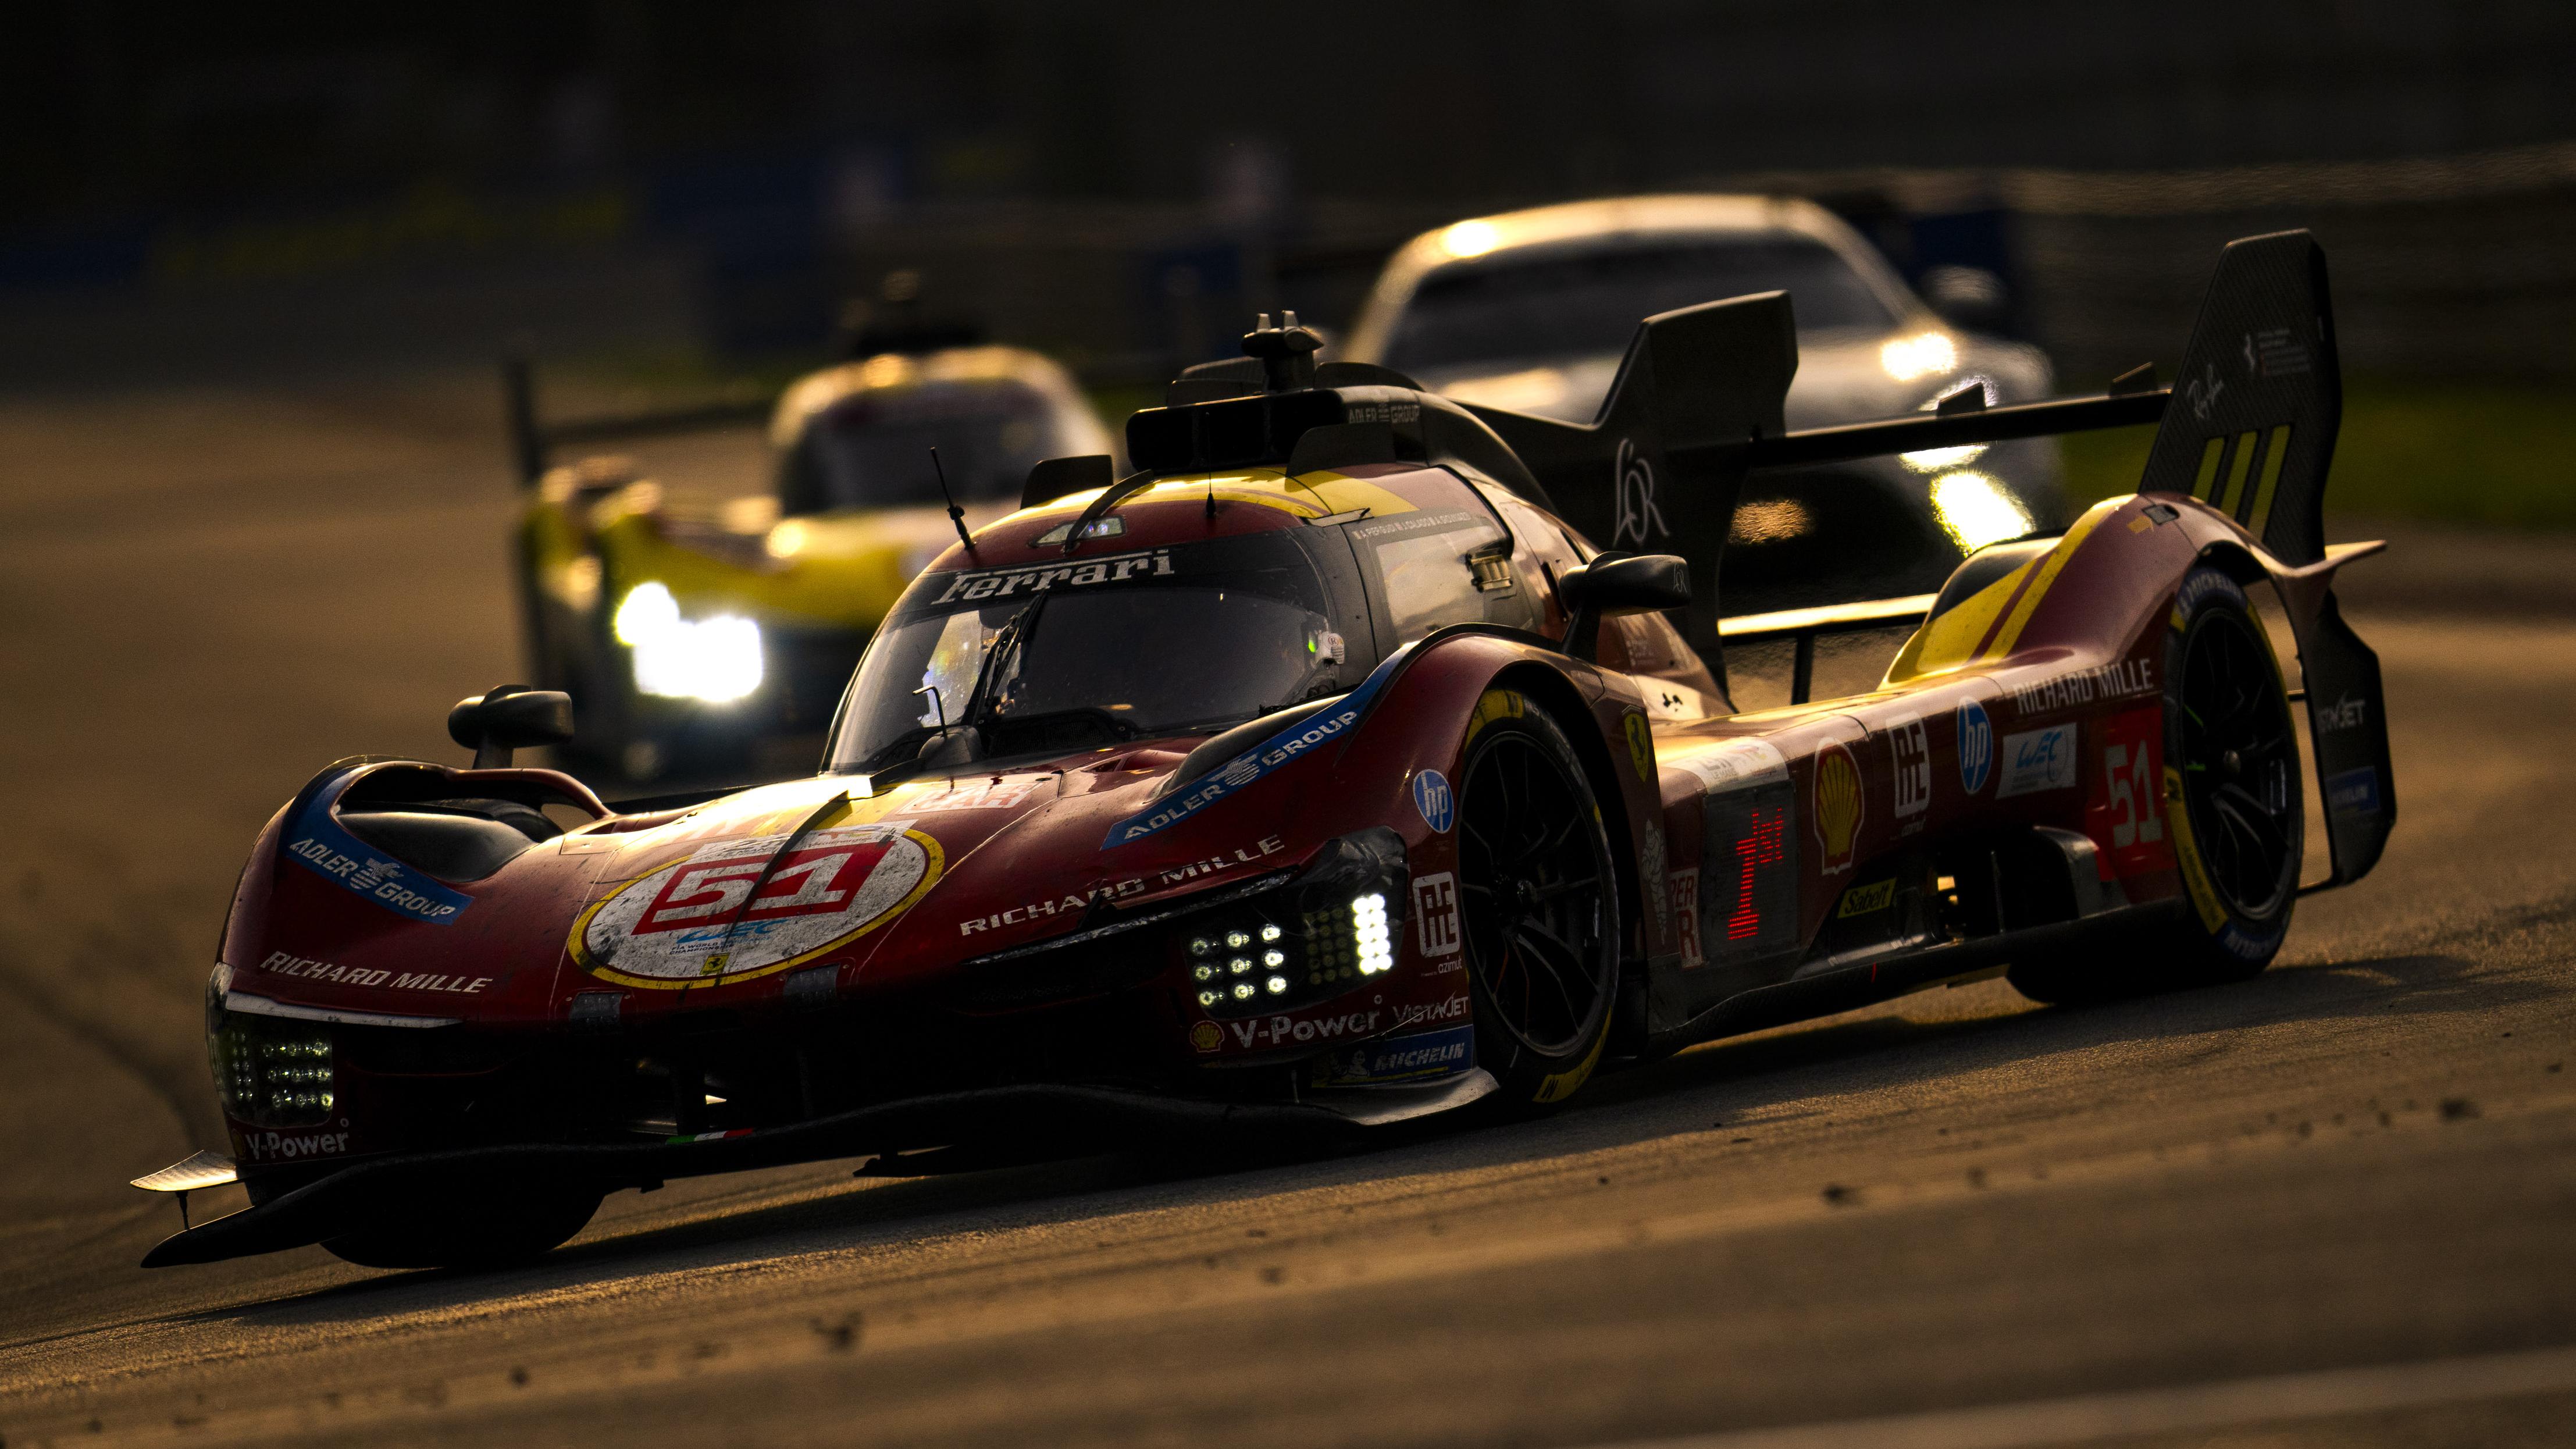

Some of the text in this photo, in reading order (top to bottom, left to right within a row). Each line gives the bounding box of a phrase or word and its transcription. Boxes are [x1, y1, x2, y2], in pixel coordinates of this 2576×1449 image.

[931, 549, 1175, 605] Ferrari
[2016, 658, 2154, 716] RICHARD MILLE
[1960, 702, 1989, 791] hp
[1123, 710, 1358, 840] ADLER GROUP
[1419, 771, 1452, 833] hp
[2104, 739, 2164, 850] 51
[290, 837, 457, 918] ADLER GROUP
[650, 851, 856, 924] 51
[960, 834, 1285, 937] RICHARD MILLE
[1844, 883, 1889, 914] Sabelt
[259, 950, 493, 994] RICHARD MILLE
[669, 944, 735, 955] CHAMPIONSHIP
[687, 941, 719, 949] WORLD
[1437, 955, 1463, 976] azimut
[1230, 1010, 1382, 1049] V-Power
[1374, 1042, 1465, 1071] MICHELIN
[245, 1130, 349, 1160] V-Power
